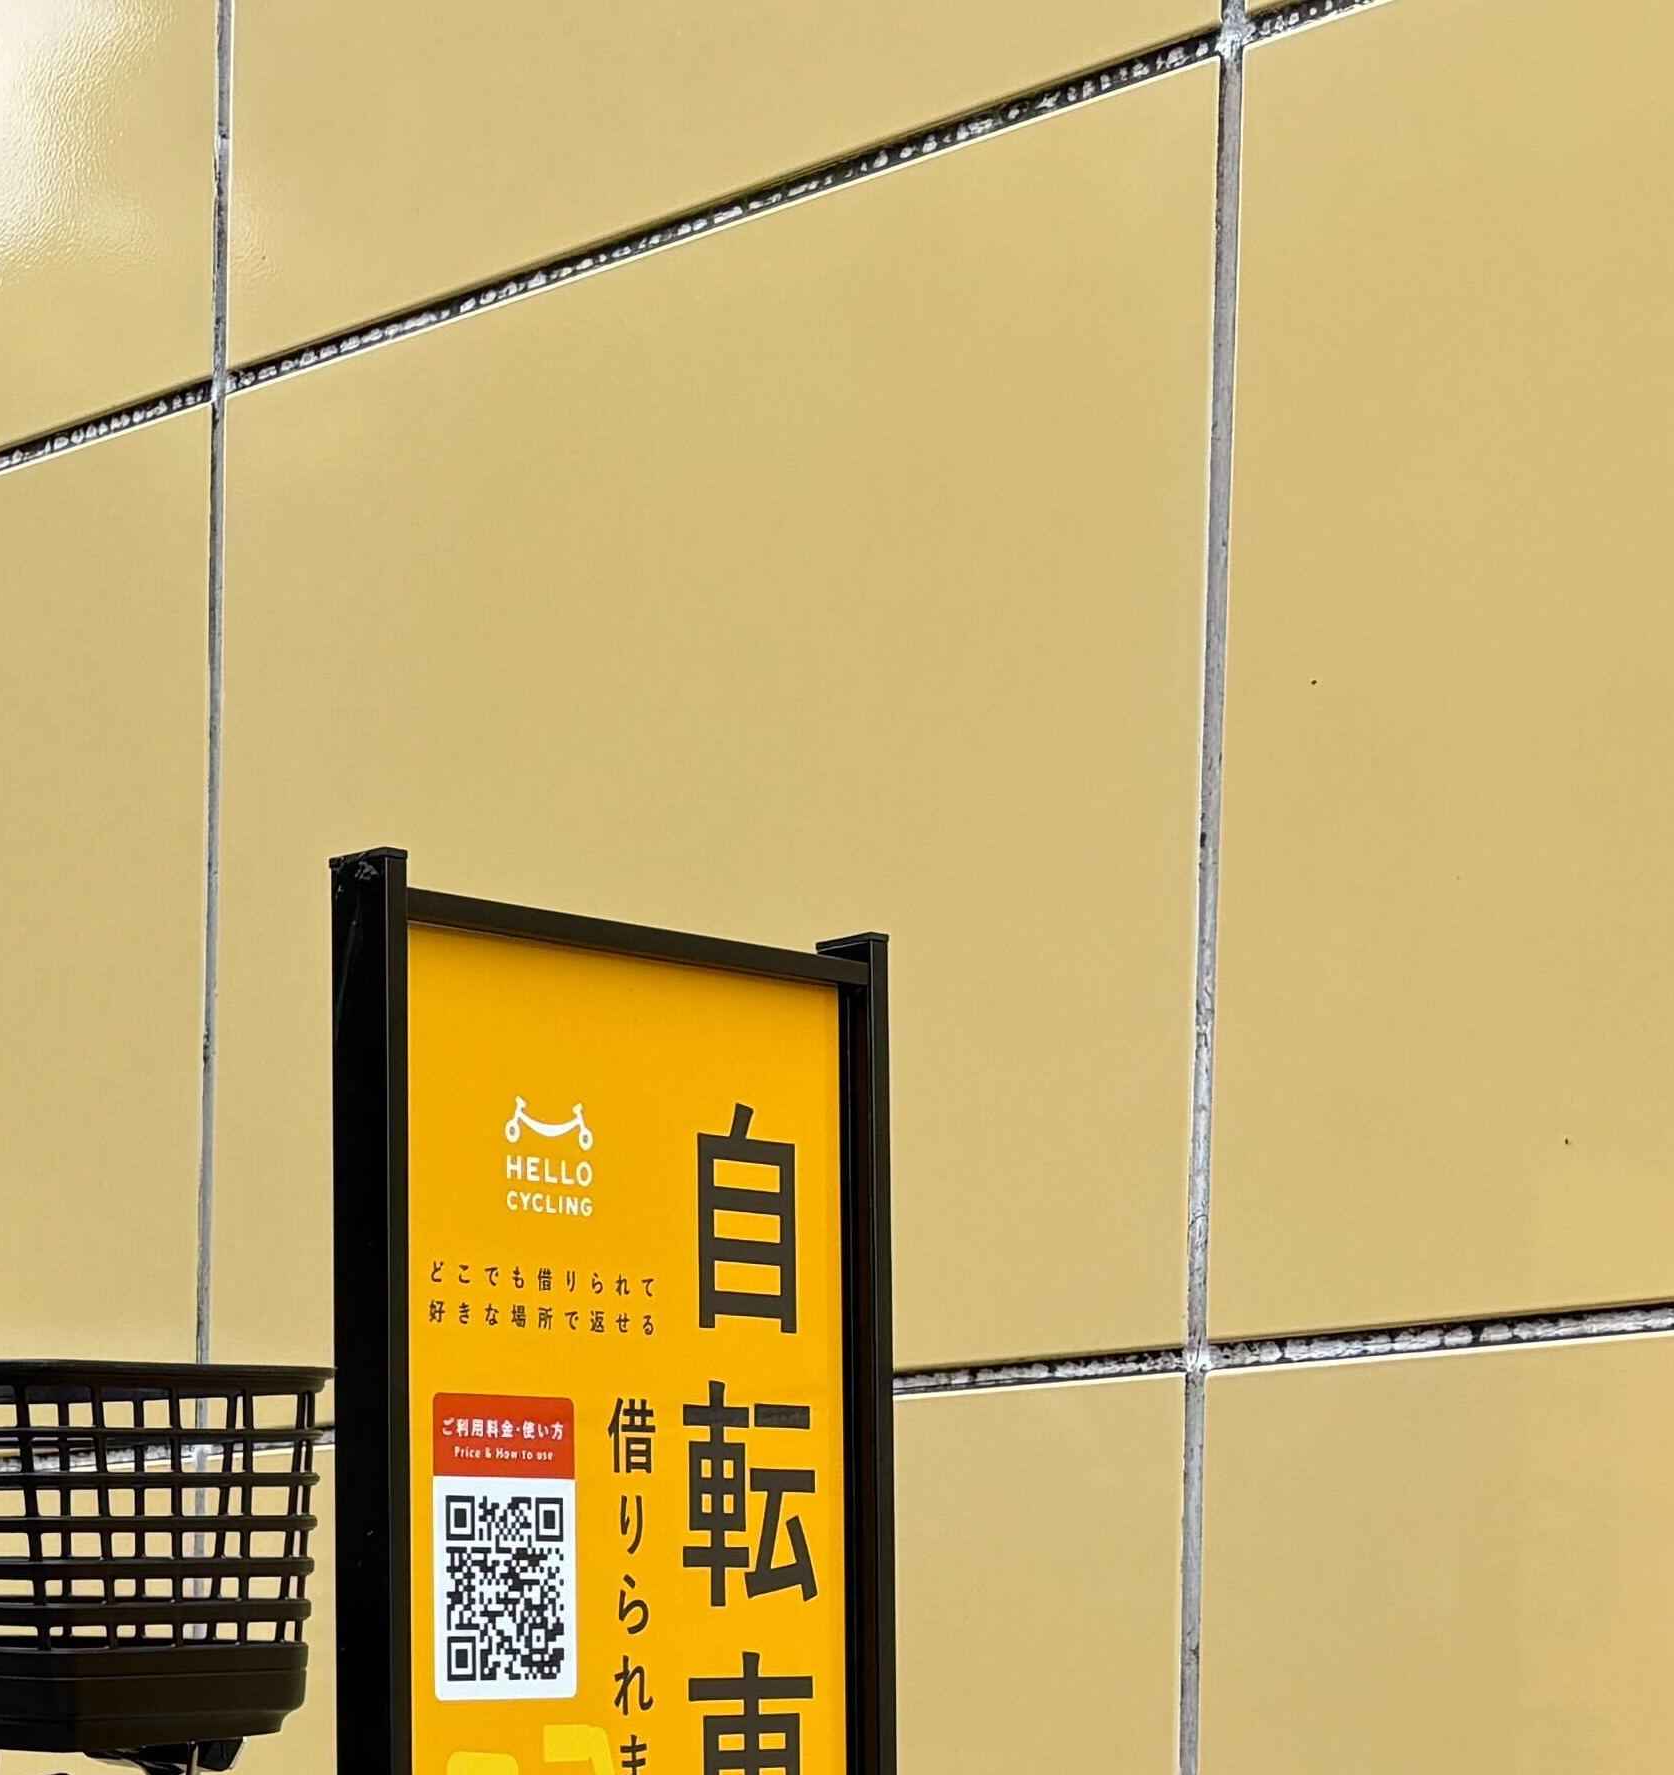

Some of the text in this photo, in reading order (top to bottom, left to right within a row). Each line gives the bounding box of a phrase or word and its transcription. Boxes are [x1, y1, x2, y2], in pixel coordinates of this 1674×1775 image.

[506, 1155, 593, 1187] HELLO
[506, 1190, 593, 1217] CYCLING
[430, 1261, 655, 1297] どこでも借りられて
[429, 1300, 654, 1335] 好きな場所で返せる
[454, 1446, 554, 1461] Price & How to use
